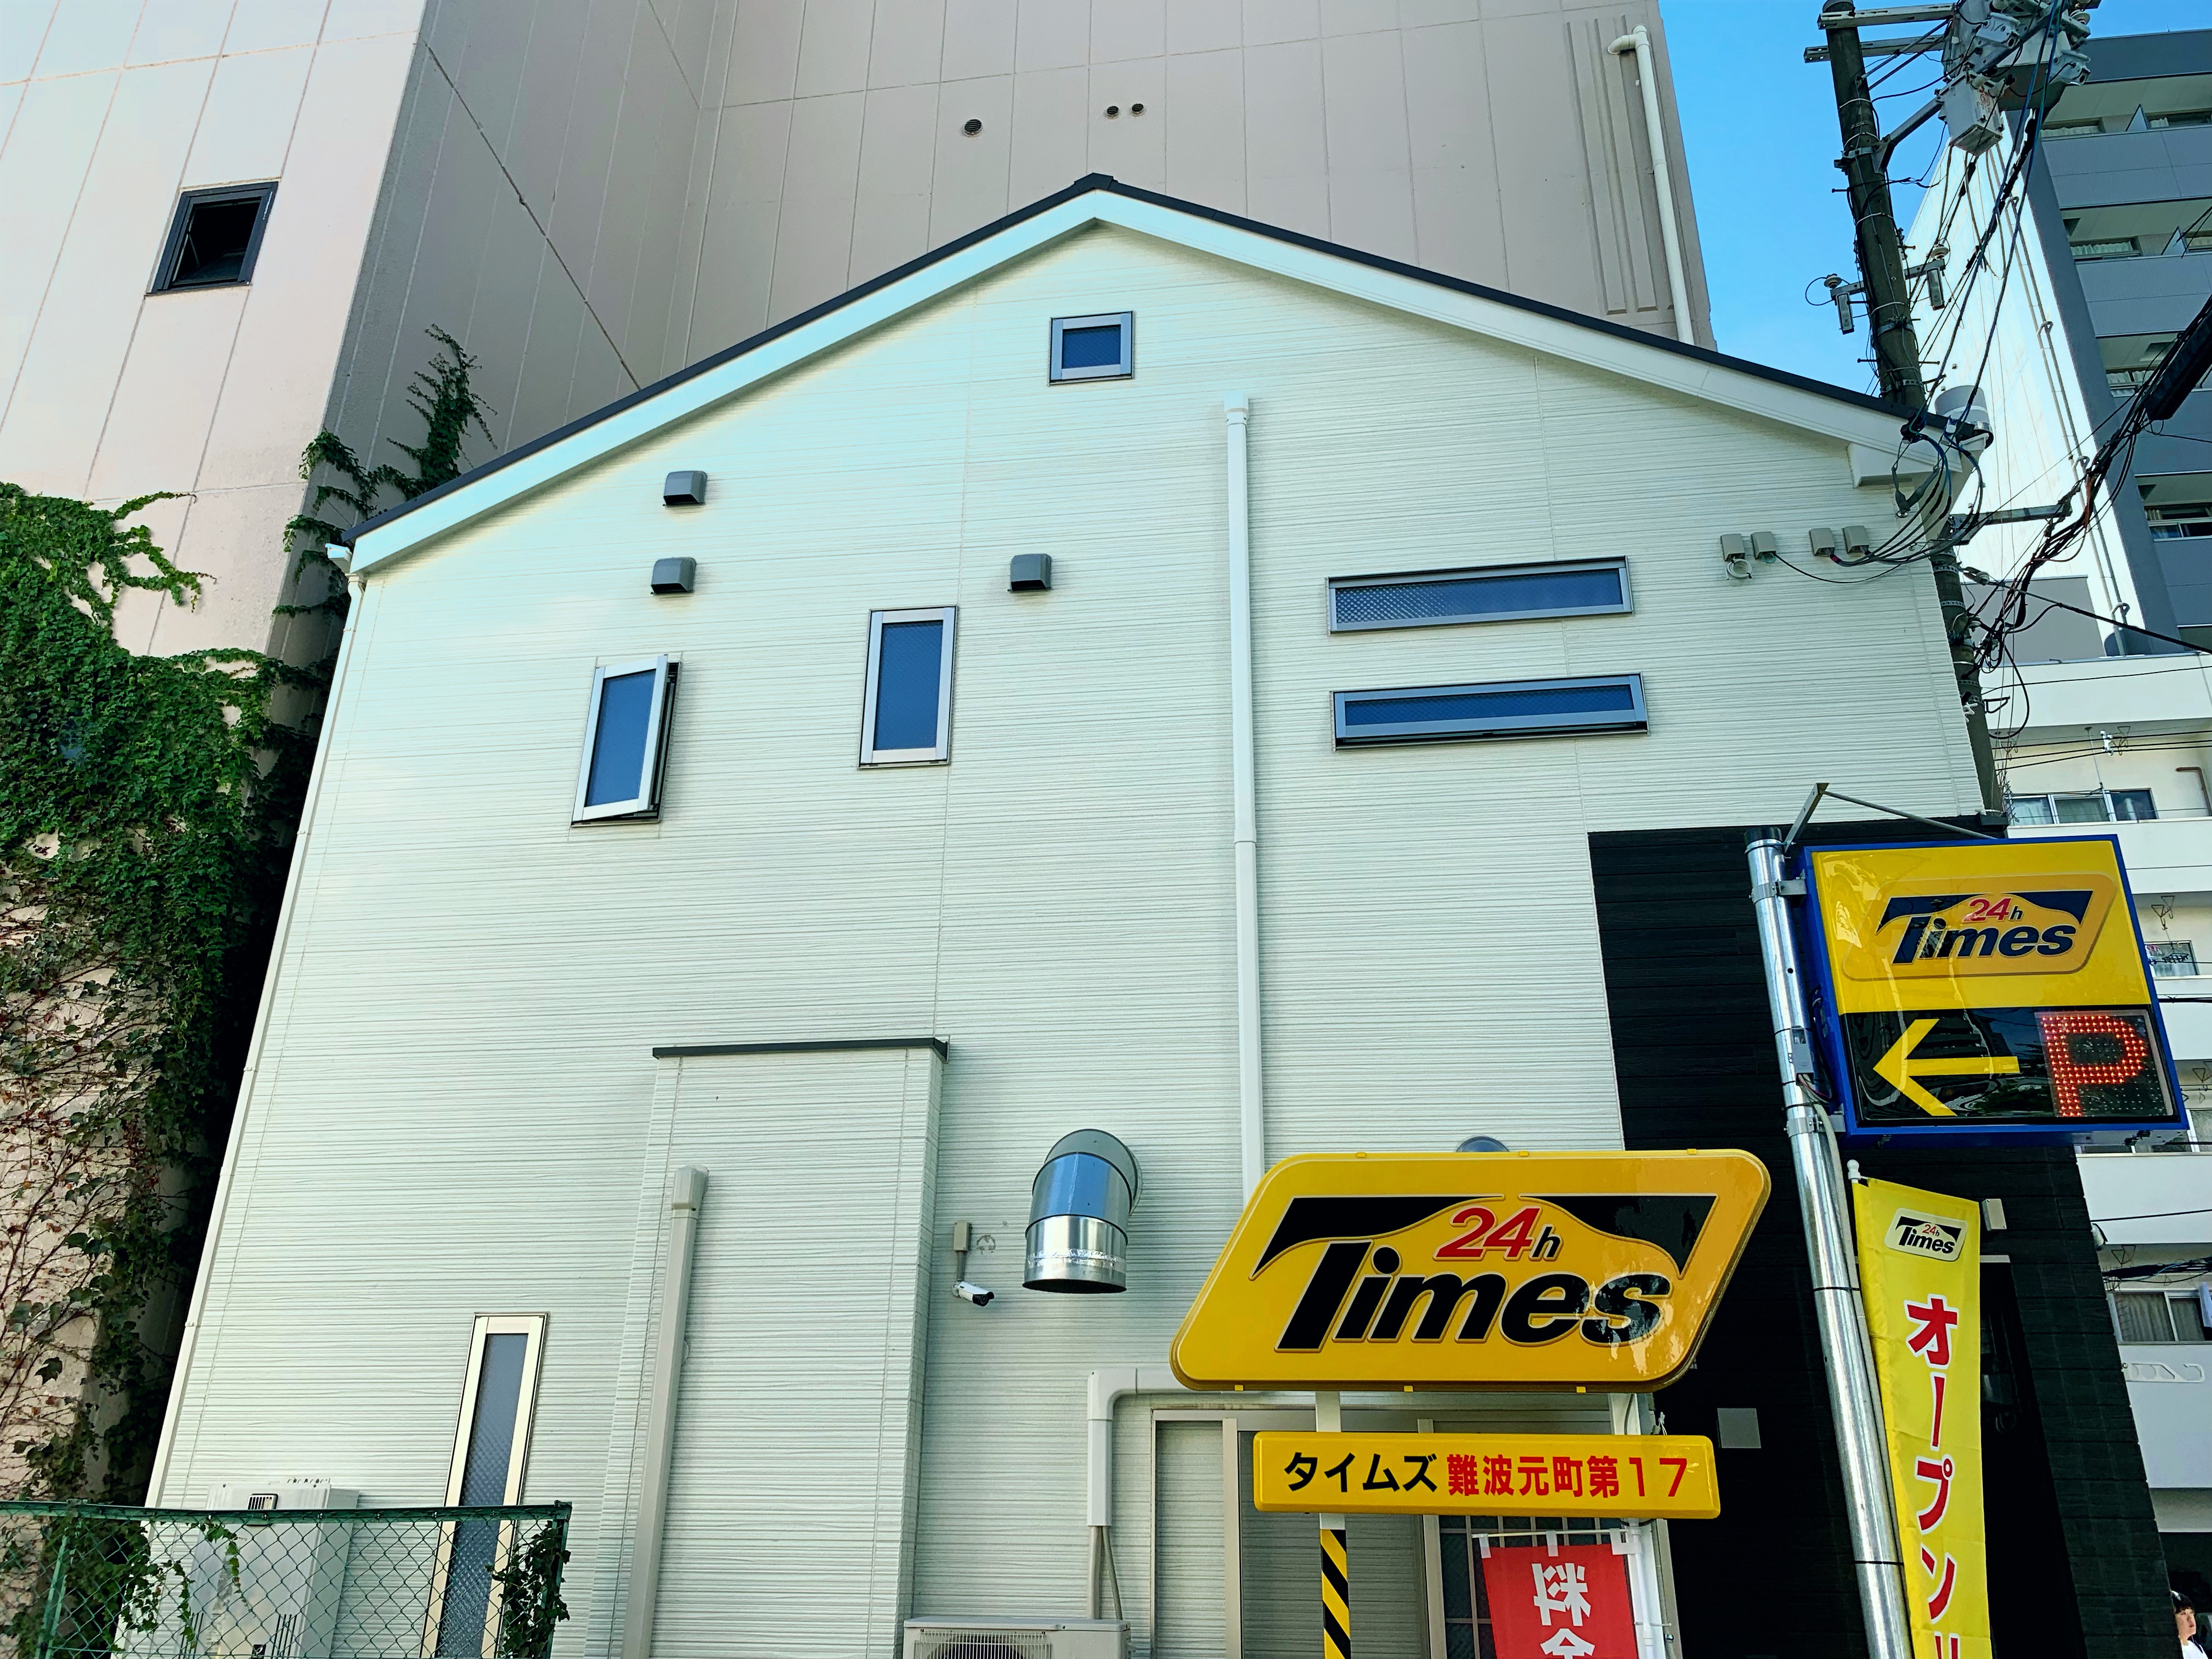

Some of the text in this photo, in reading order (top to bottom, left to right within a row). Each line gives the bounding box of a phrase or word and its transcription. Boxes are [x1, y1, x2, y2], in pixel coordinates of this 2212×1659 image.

[1962, 898, 2023, 923] 24h
[1892, 916, 2076, 965] Times
[2040, 1014, 2147, 1118] P
[1436, 1206, 1561, 1261] 24h
[1898, 1226, 1955, 1254] Times
[1922, 1224, 1940, 1237] 24h
[1277, 1240, 1671, 1352] Times
